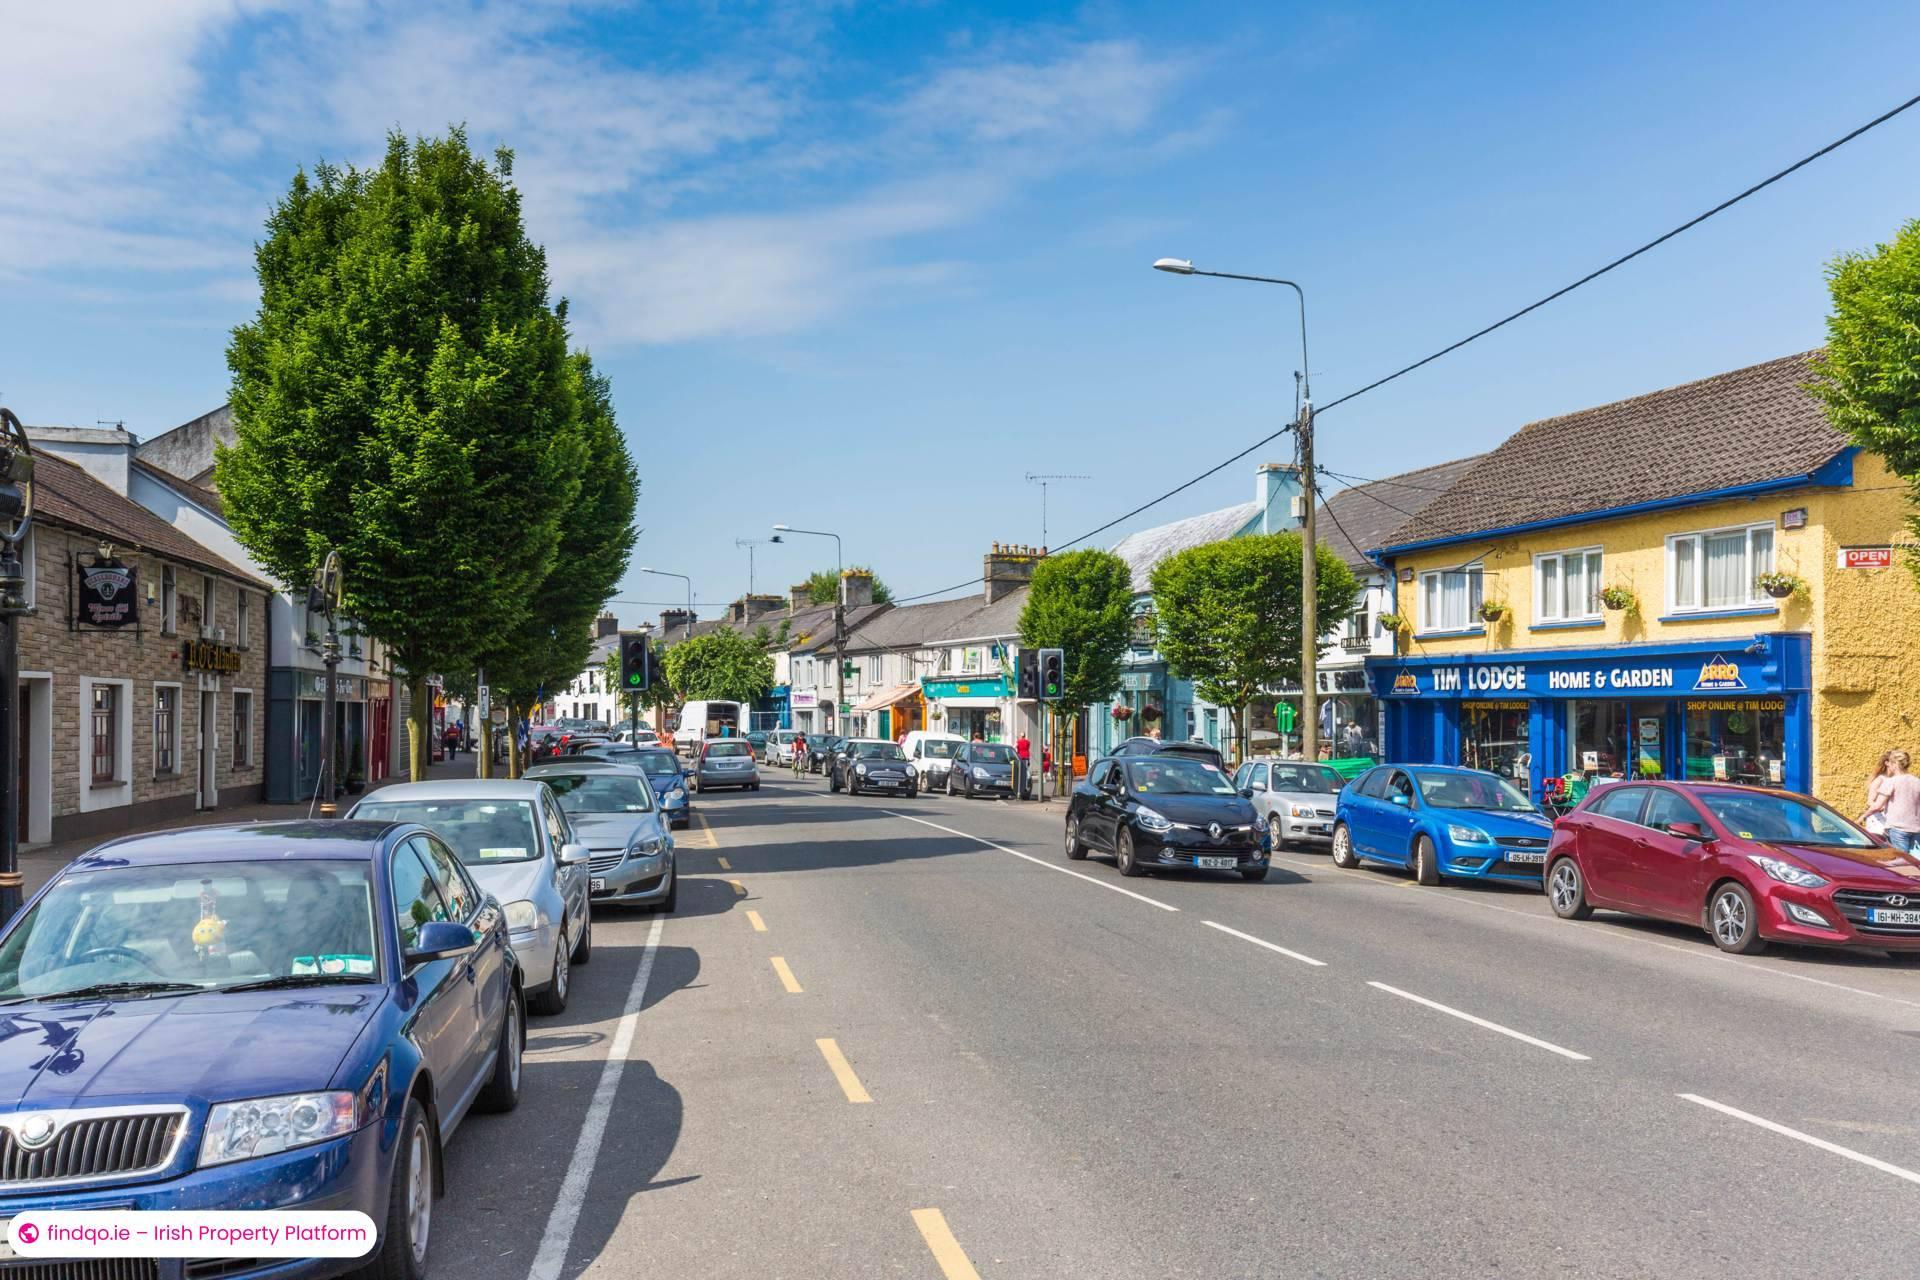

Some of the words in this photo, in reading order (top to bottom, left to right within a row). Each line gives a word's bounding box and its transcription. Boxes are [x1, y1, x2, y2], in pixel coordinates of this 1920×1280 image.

[1849, 551, 1888, 561] OPEN
[1432, 668, 1462, 691] TIM
[1468, 665, 1526, 690] LODGE
[1549, 671, 1591, 689] HOME
[1595, 671, 1606, 688] &
[1611, 668, 1673, 687] GARDEN
[1700, 663, 1739, 681] ARRO
[1687, 701, 1707, 710] SHOP
[1709, 701, 1736, 710] ONLINE
[1745, 701, 1759, 710] TIM
[1877, 911, 1920, 923] 161-MH-384
